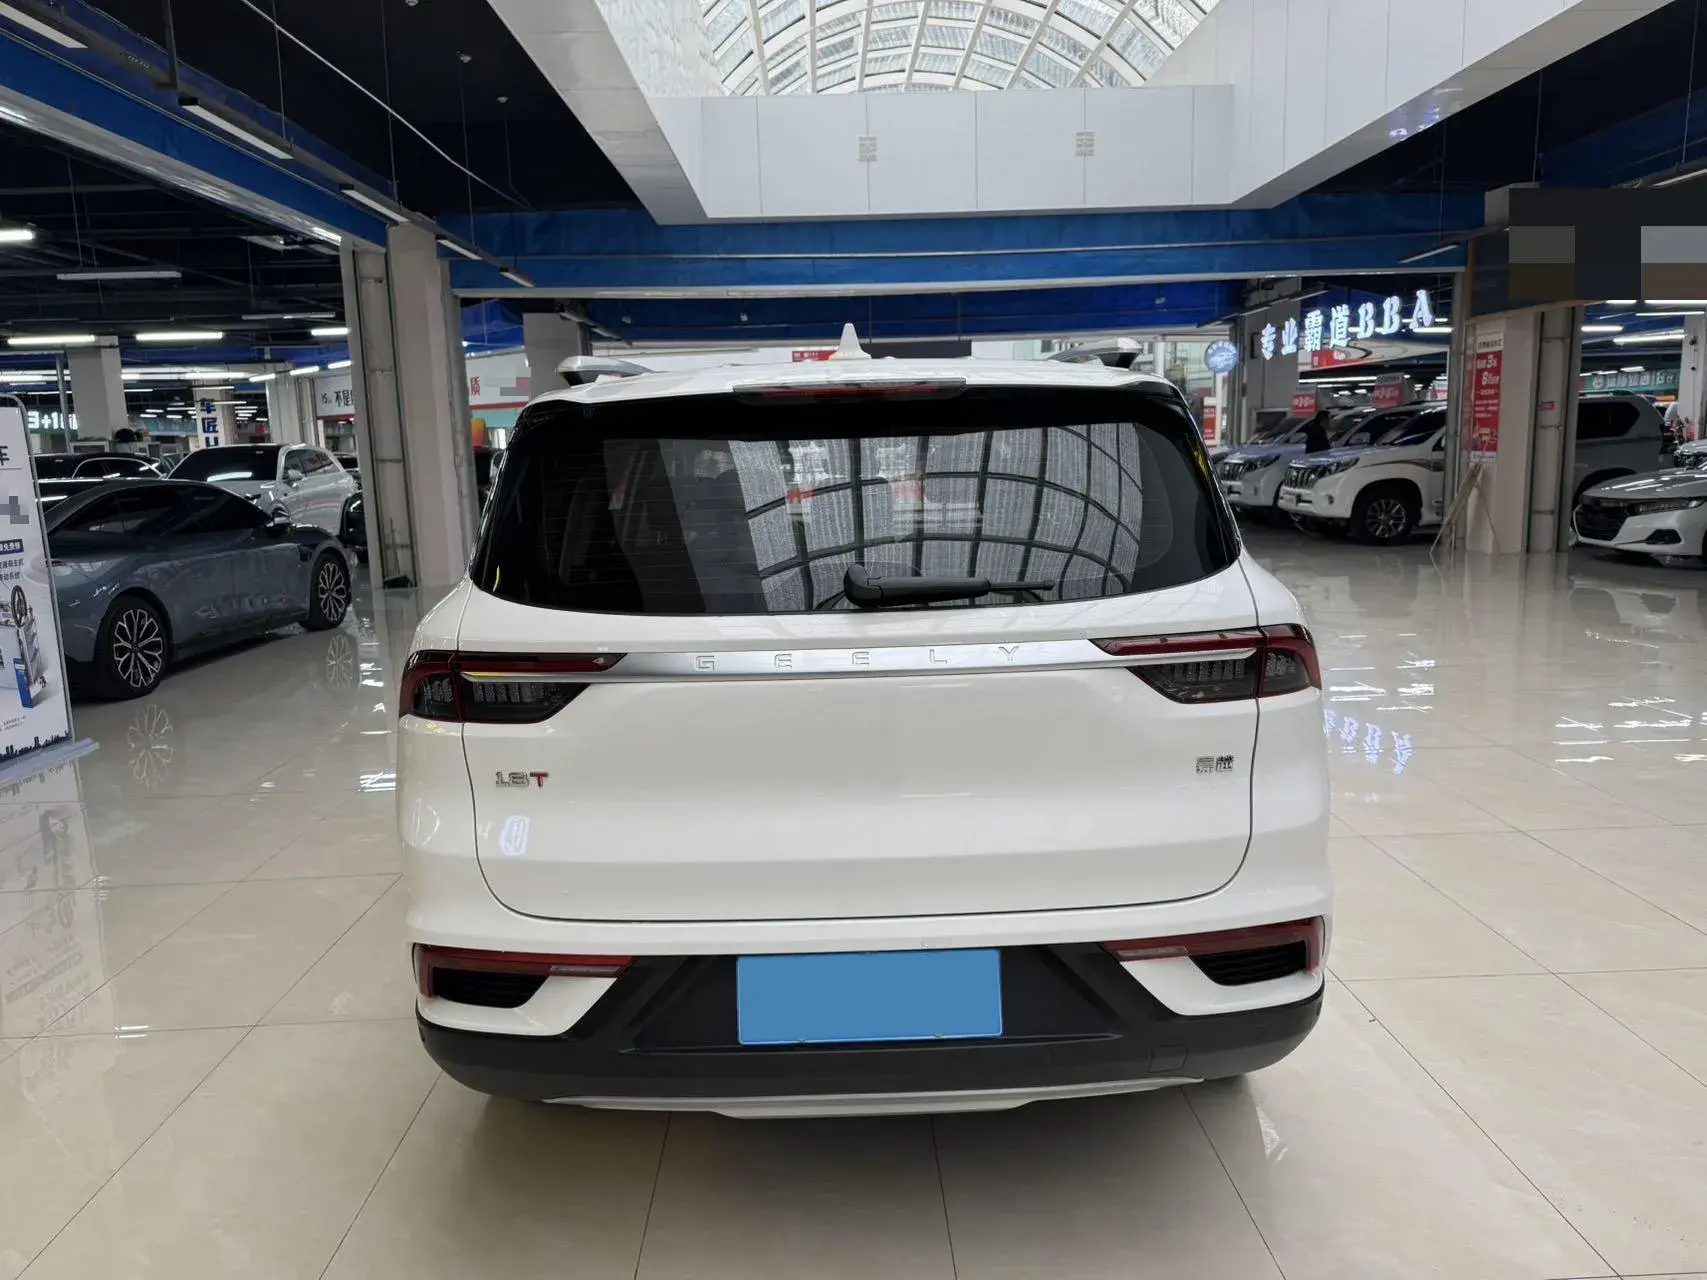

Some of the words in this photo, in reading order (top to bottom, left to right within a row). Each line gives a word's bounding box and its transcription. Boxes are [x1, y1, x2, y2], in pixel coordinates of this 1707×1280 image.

[1261, 289, 1433, 360] 专业霸道BBA
[694, 645, 1021, 672] GEELY
